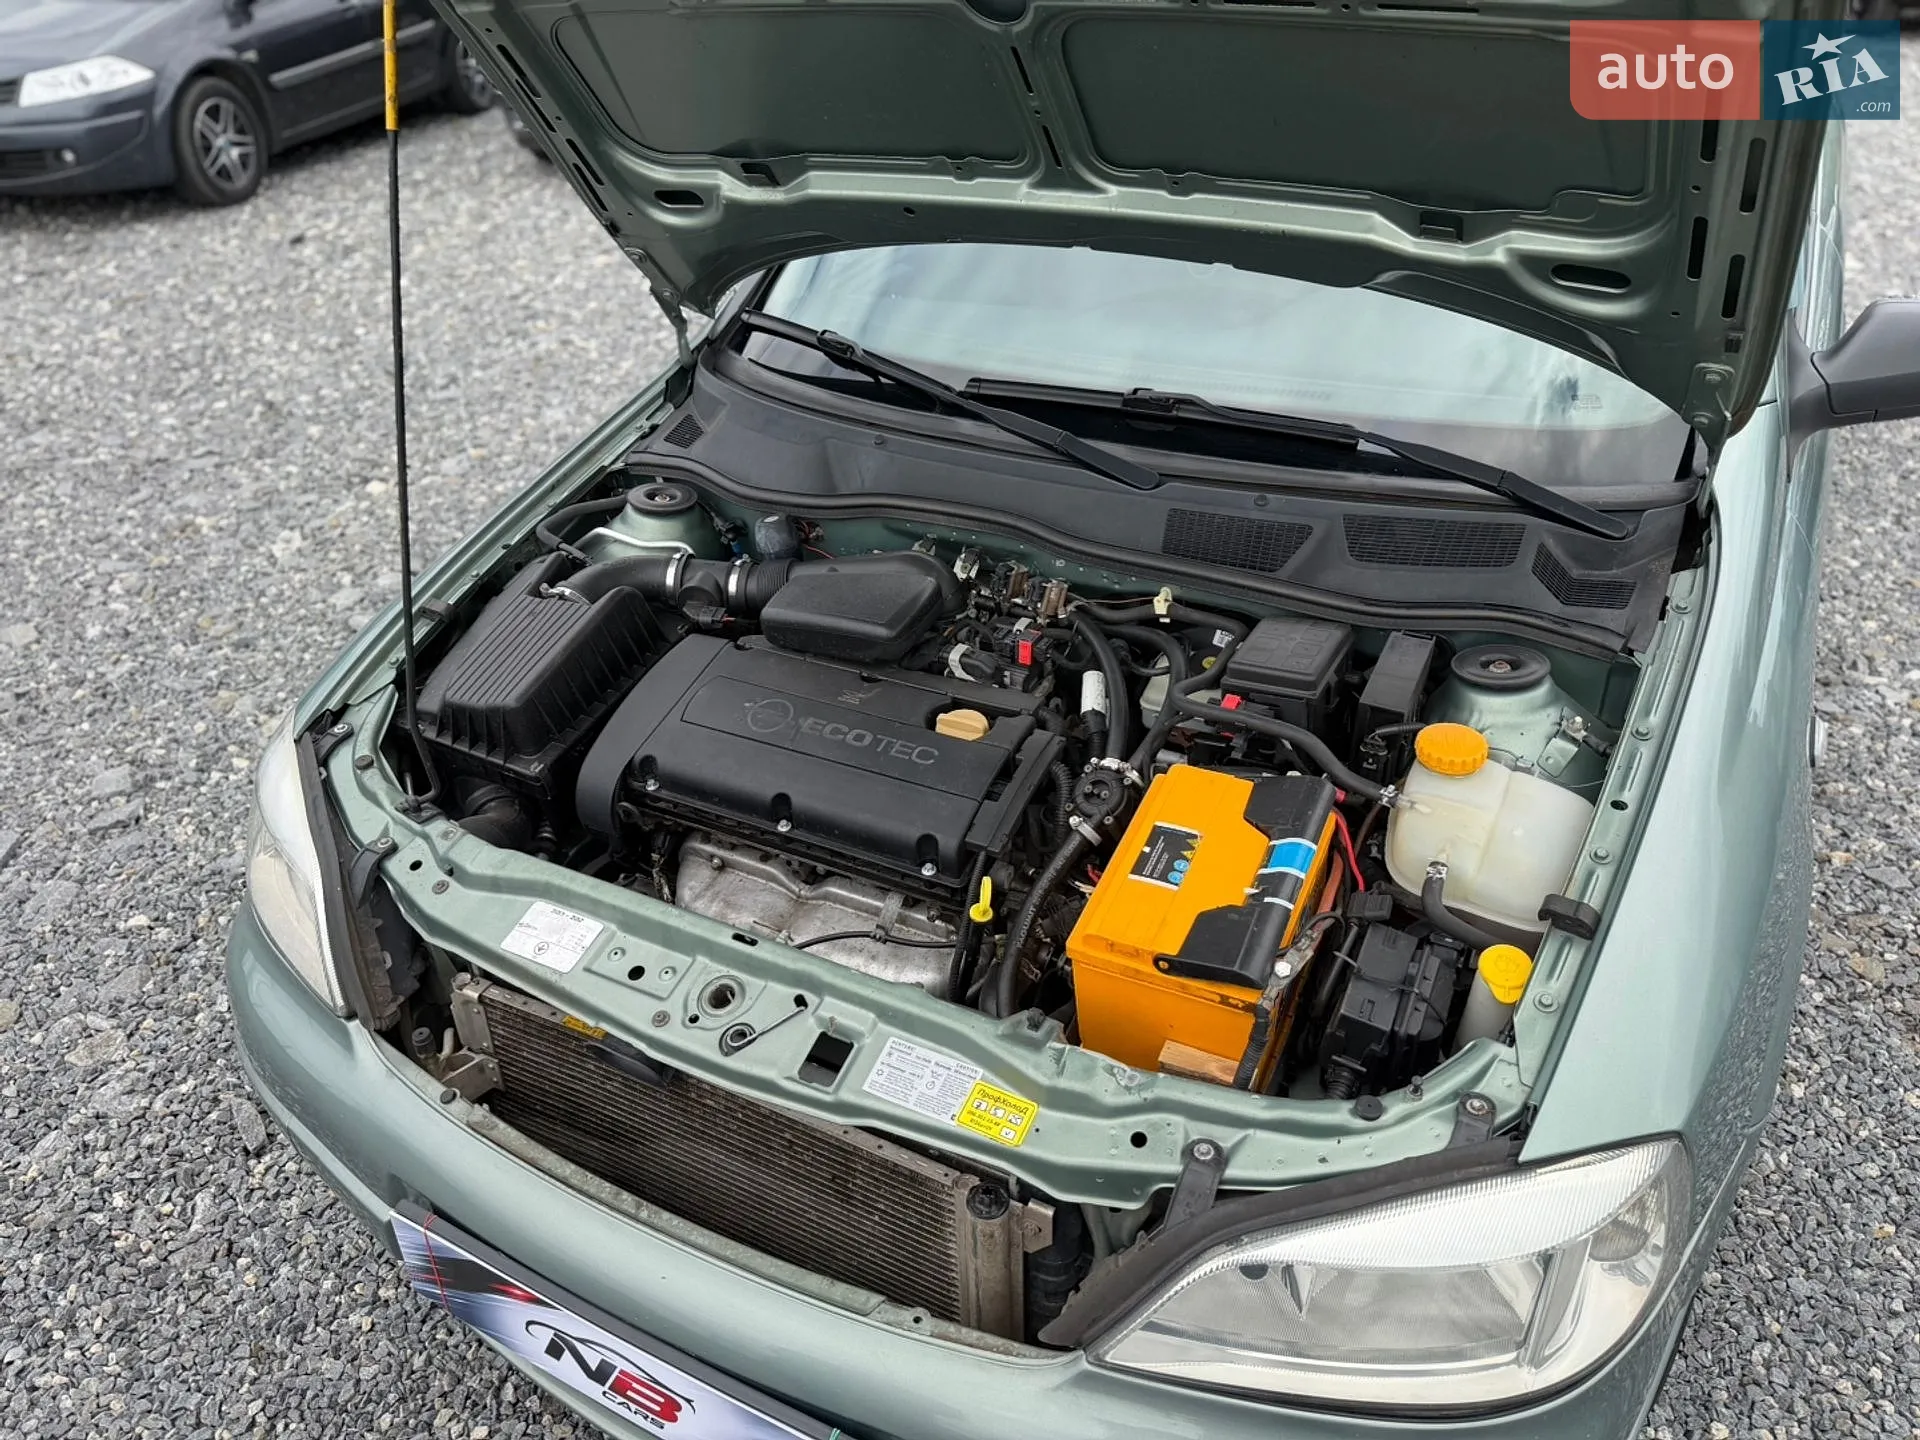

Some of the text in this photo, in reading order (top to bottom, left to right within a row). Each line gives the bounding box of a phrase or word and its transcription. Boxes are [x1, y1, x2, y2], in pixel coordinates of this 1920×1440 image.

[800, 716, 939, 764] ECOTEC
[544, 1331, 683, 1423] NB
[602, 1390, 666, 1430] CARS
